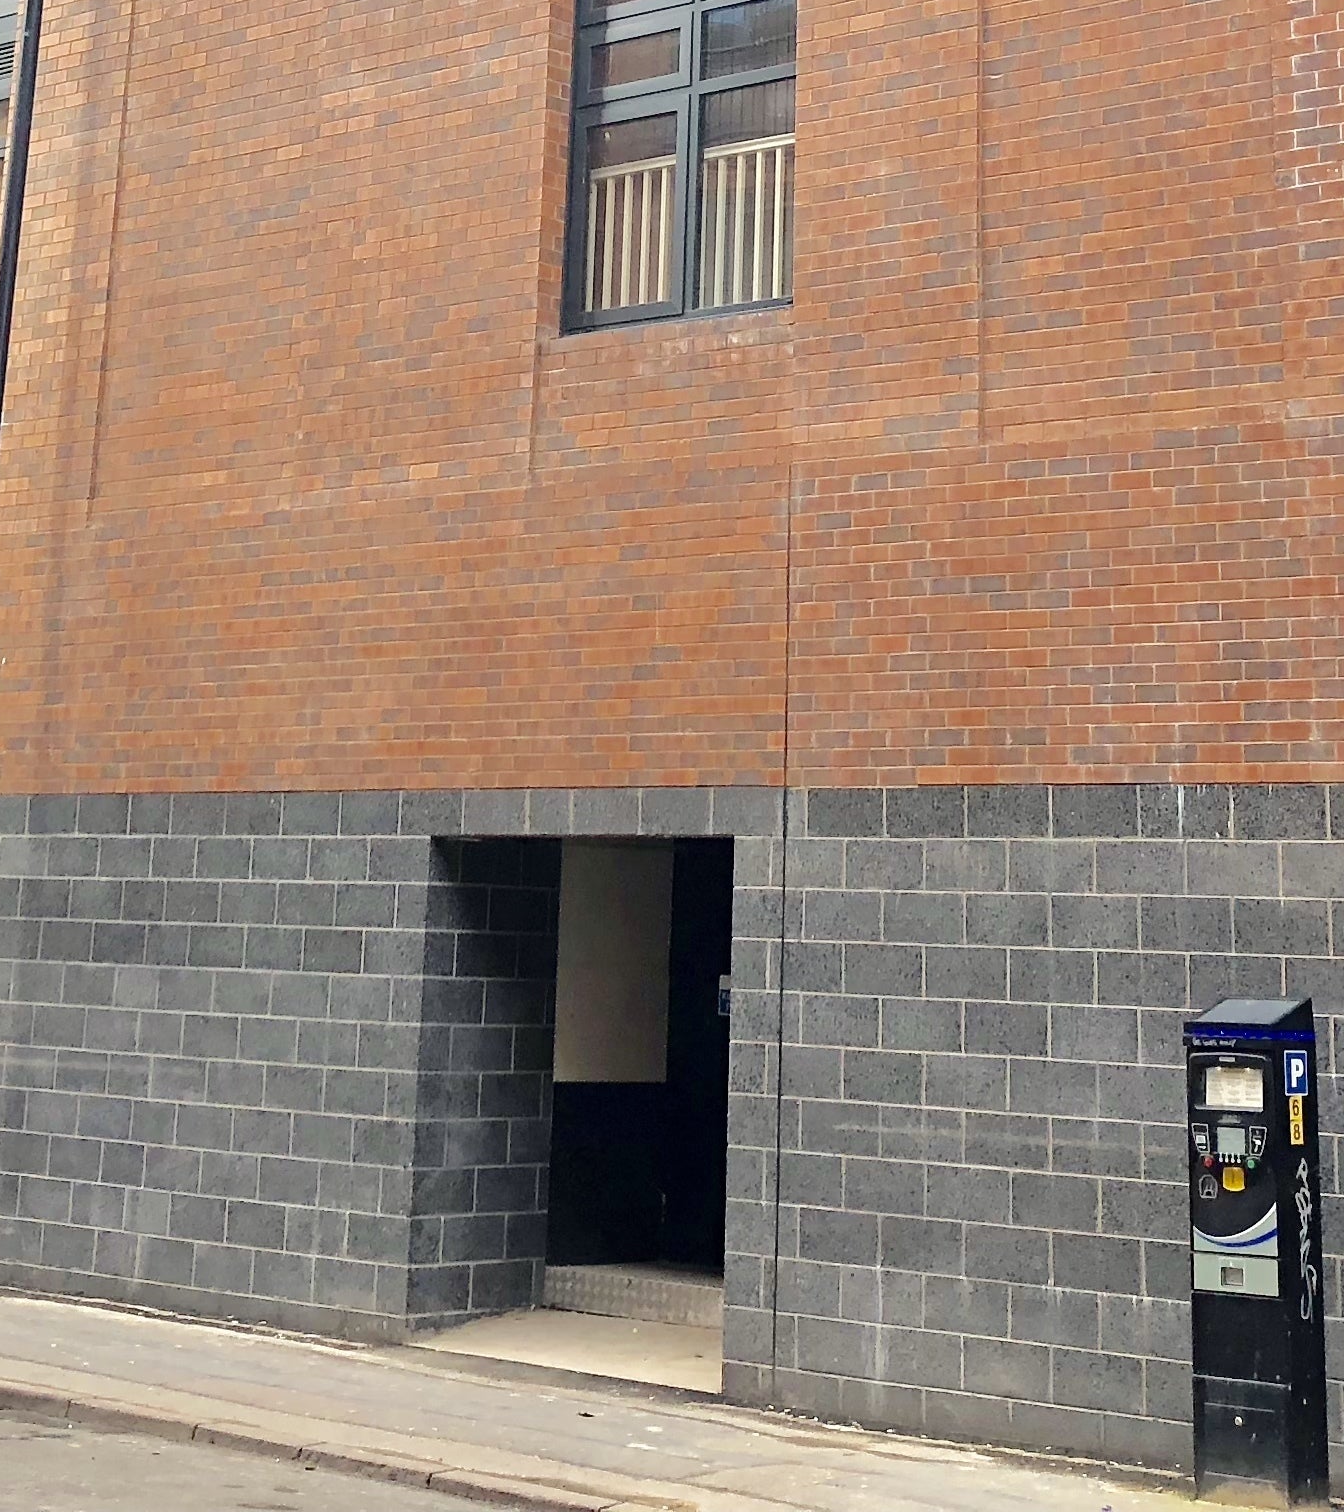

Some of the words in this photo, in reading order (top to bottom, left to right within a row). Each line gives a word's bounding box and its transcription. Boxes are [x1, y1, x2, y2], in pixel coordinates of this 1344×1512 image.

[1290, 1058, 1304, 1088] P
[1292, 1099, 1300, 1117] 6
[1293, 1123, 1301, 1141] 8
